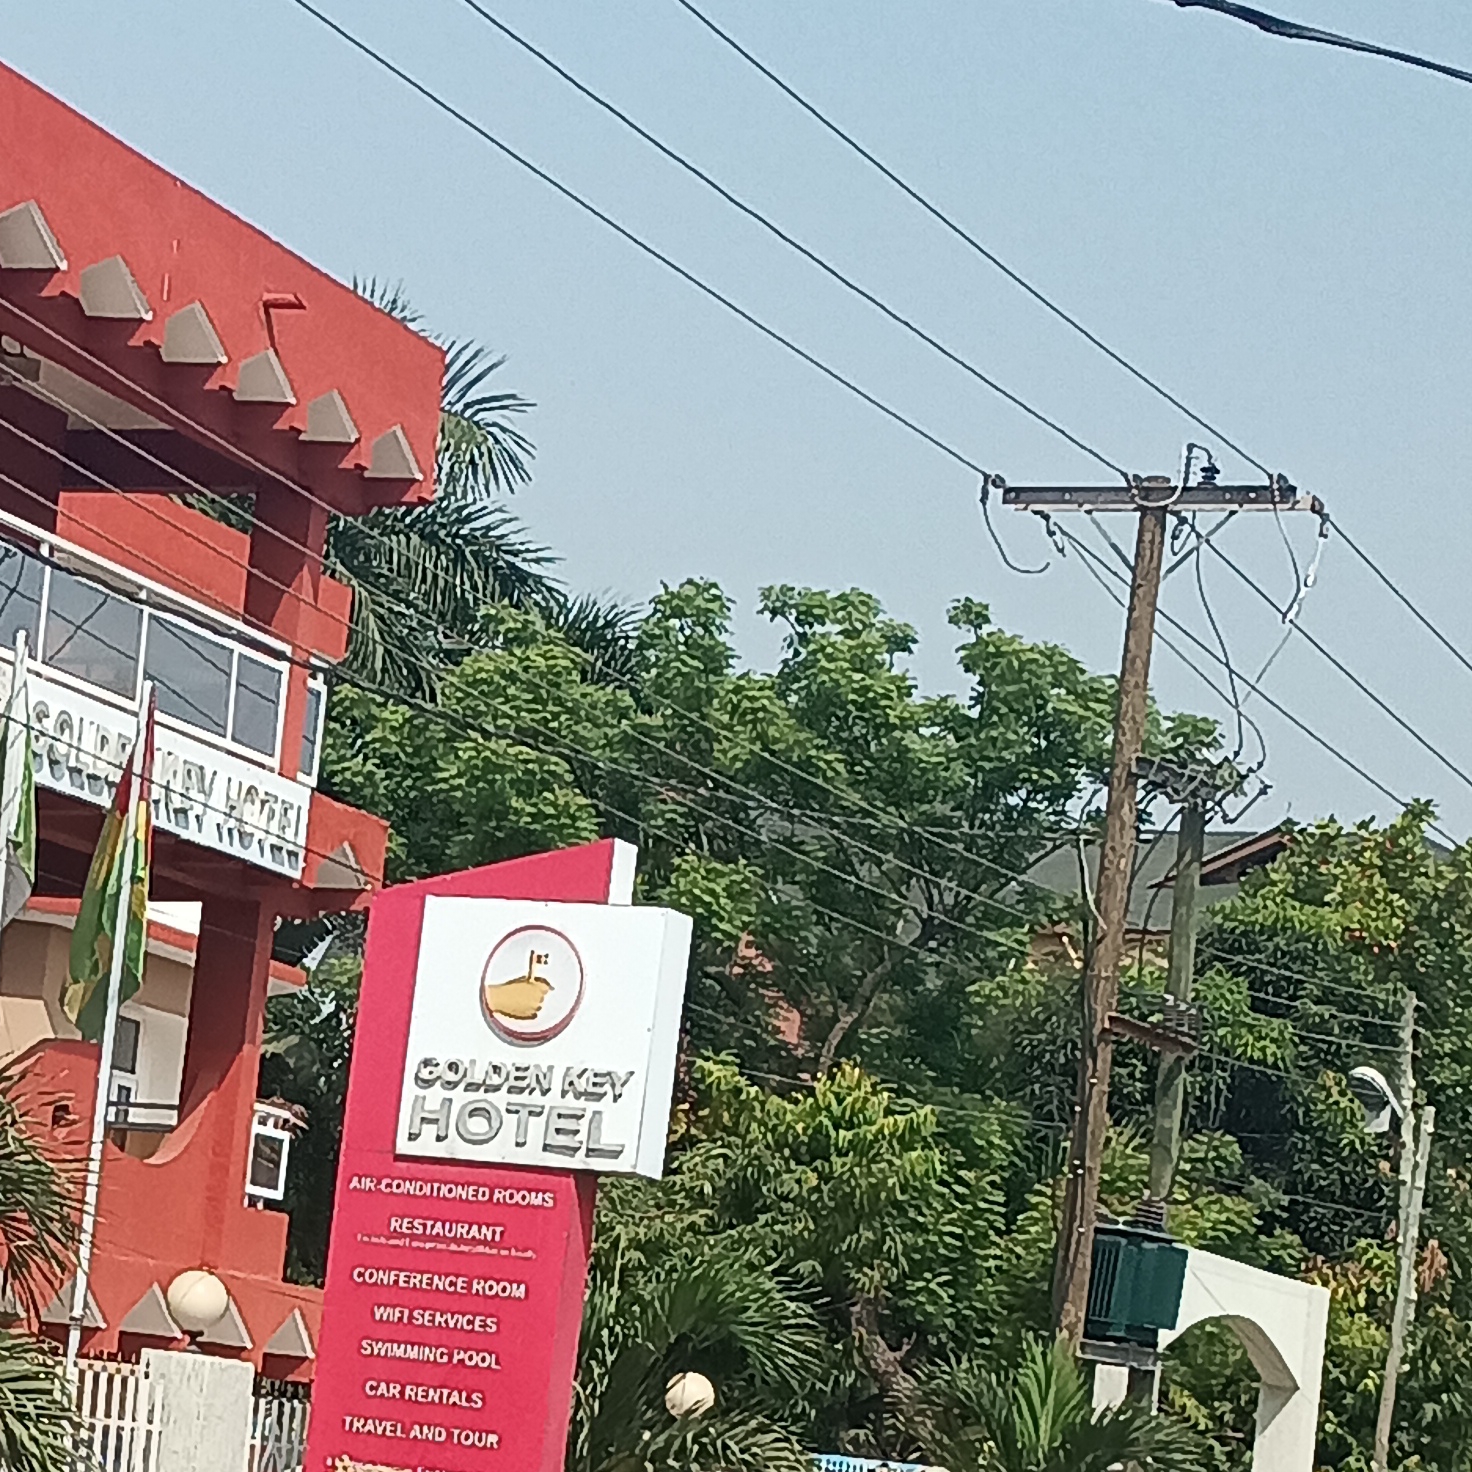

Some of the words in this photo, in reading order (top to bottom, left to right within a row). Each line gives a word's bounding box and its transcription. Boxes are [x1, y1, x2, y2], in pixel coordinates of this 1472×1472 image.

[30, 700, 134, 800] GOLDE
[216, 777, 303, 872] HOTEL
[415, 1056, 552, 1097] GOLDEN
[561, 1067, 635, 1103] KEY
[407, 1095, 626, 1159] HOTEL
[348, 1175, 491, 1202] AIR-CONDITIONED
[492, 1188, 555, 1208] ROOMS
[389, 1216, 505, 1243] RESTAURANT
[352, 1266, 468, 1294] CONFERENCE
[471, 1279, 526, 1300] ROOM
[373, 1305, 409, 1324] WIFI
[412, 1309, 498, 1333] SERVICES
[360, 1339, 449, 1364] SWIMMING
[452, 1350, 502, 1370] POOL
[364, 1380, 402, 1399] CAR
[404, 1384, 484, 1409] RENTALS
[342, 1415, 407, 1439] TRAVEL
[409, 1424, 447, 1443] AND
[450, 1427, 500, 1449] TOUR
